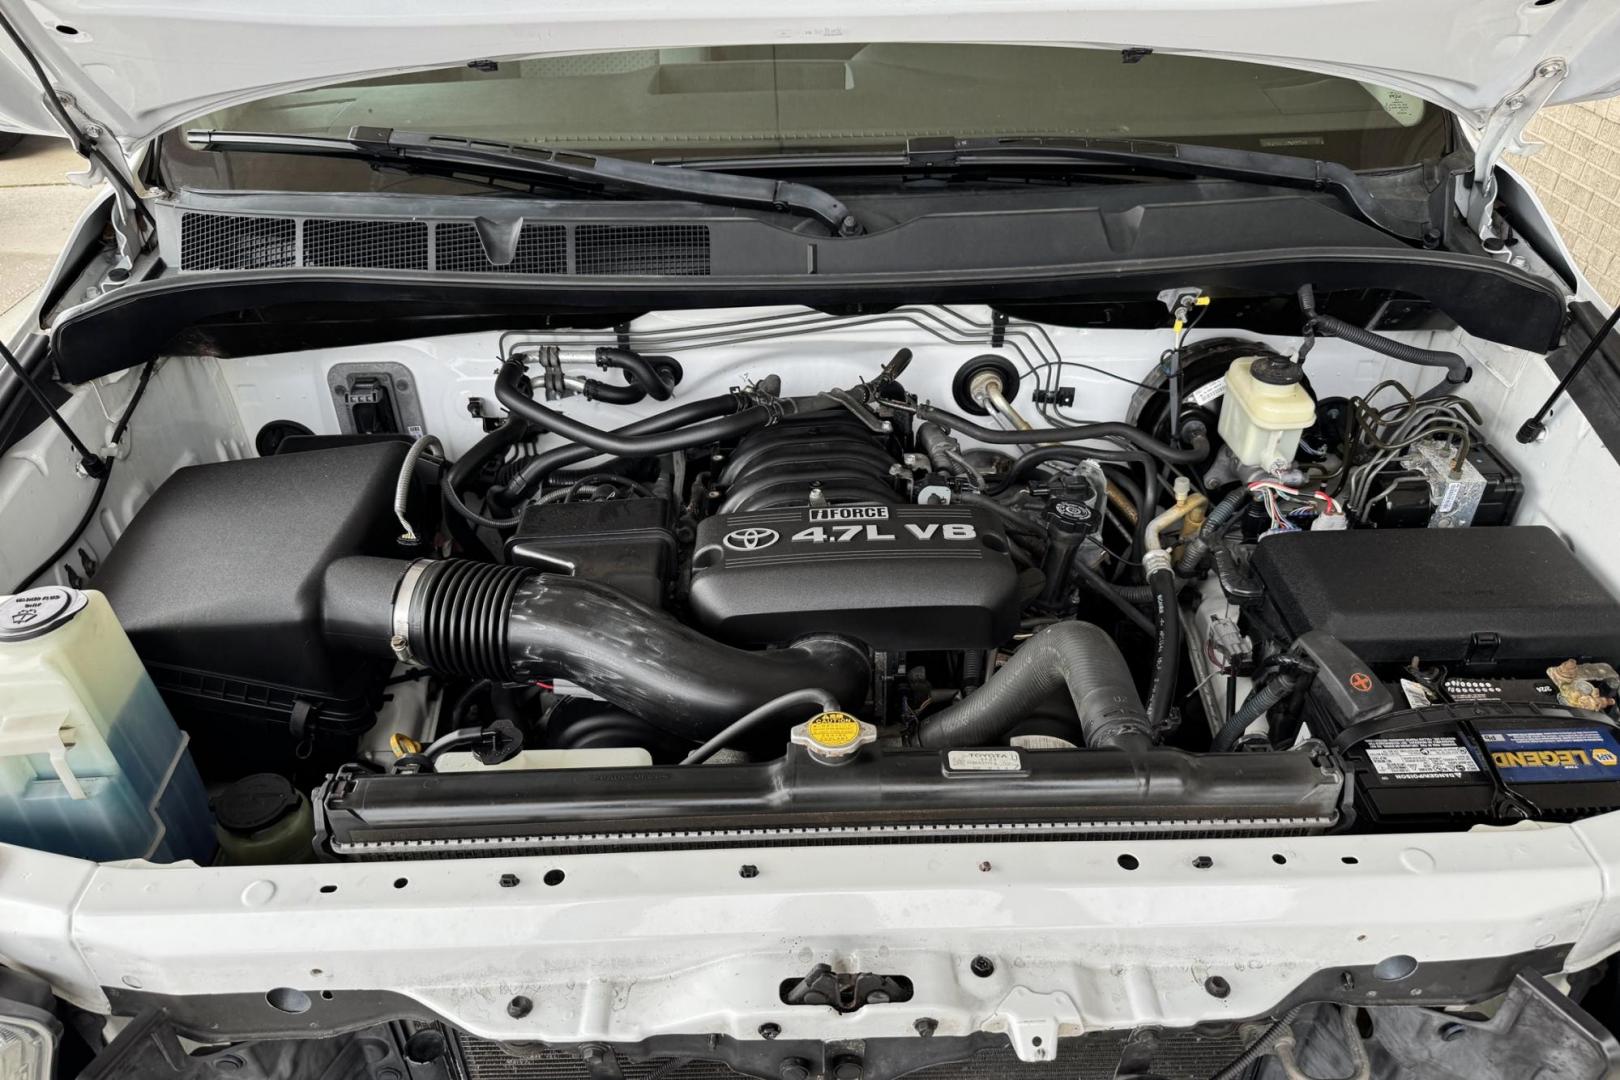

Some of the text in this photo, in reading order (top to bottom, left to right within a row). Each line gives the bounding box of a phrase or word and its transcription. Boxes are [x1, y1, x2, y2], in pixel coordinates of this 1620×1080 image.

[792, 523, 977, 543] 4.7L V8
[1492, 750, 1591, 767] LEGEND
